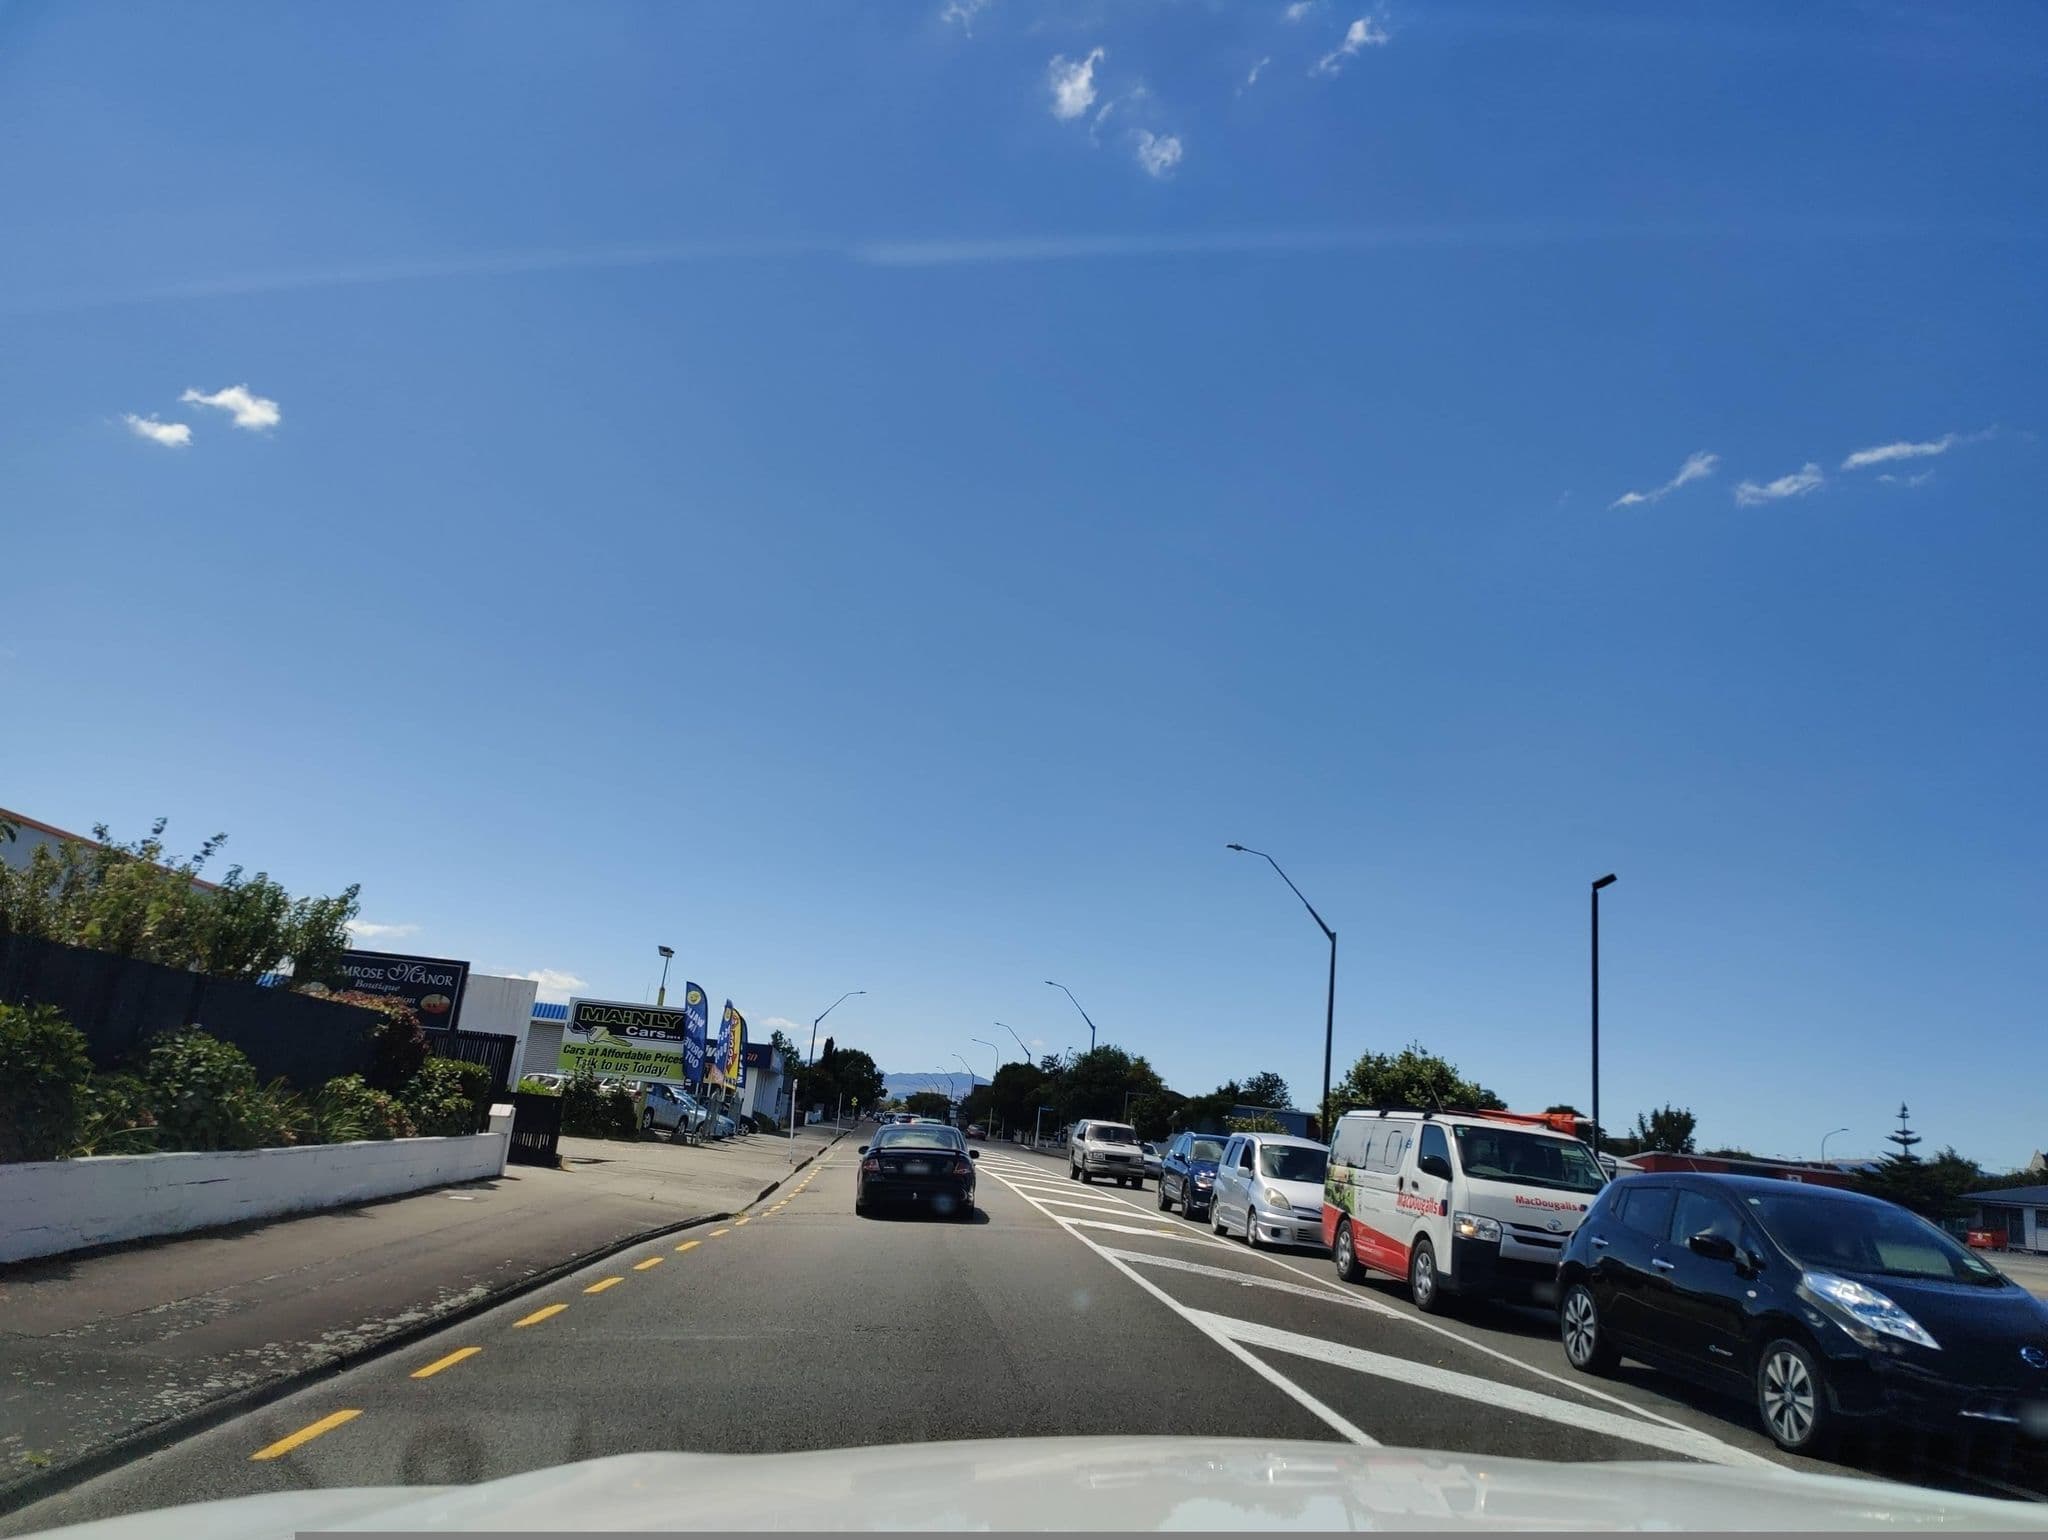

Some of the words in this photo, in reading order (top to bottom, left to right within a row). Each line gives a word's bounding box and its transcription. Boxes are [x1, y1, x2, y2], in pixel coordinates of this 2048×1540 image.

[336, 964, 384, 980] MROSE
[355, 979, 401, 993] Boutique
[625, 1025, 666, 1039] Cars
[563, 1044, 585, 1056] Cars
[587, 1046, 599, 1057] at
[600, 1047, 652, 1062] Affordable
[654, 1053, 684, 1065] Prices
[575, 1056, 598, 1070] Talk
[601, 1059, 612, 1070] to
[615, 1063, 629, 1072] us
[632, 1061, 670, 1077] Today!
[1515, 1195, 1578, 1211] MacDougalls
